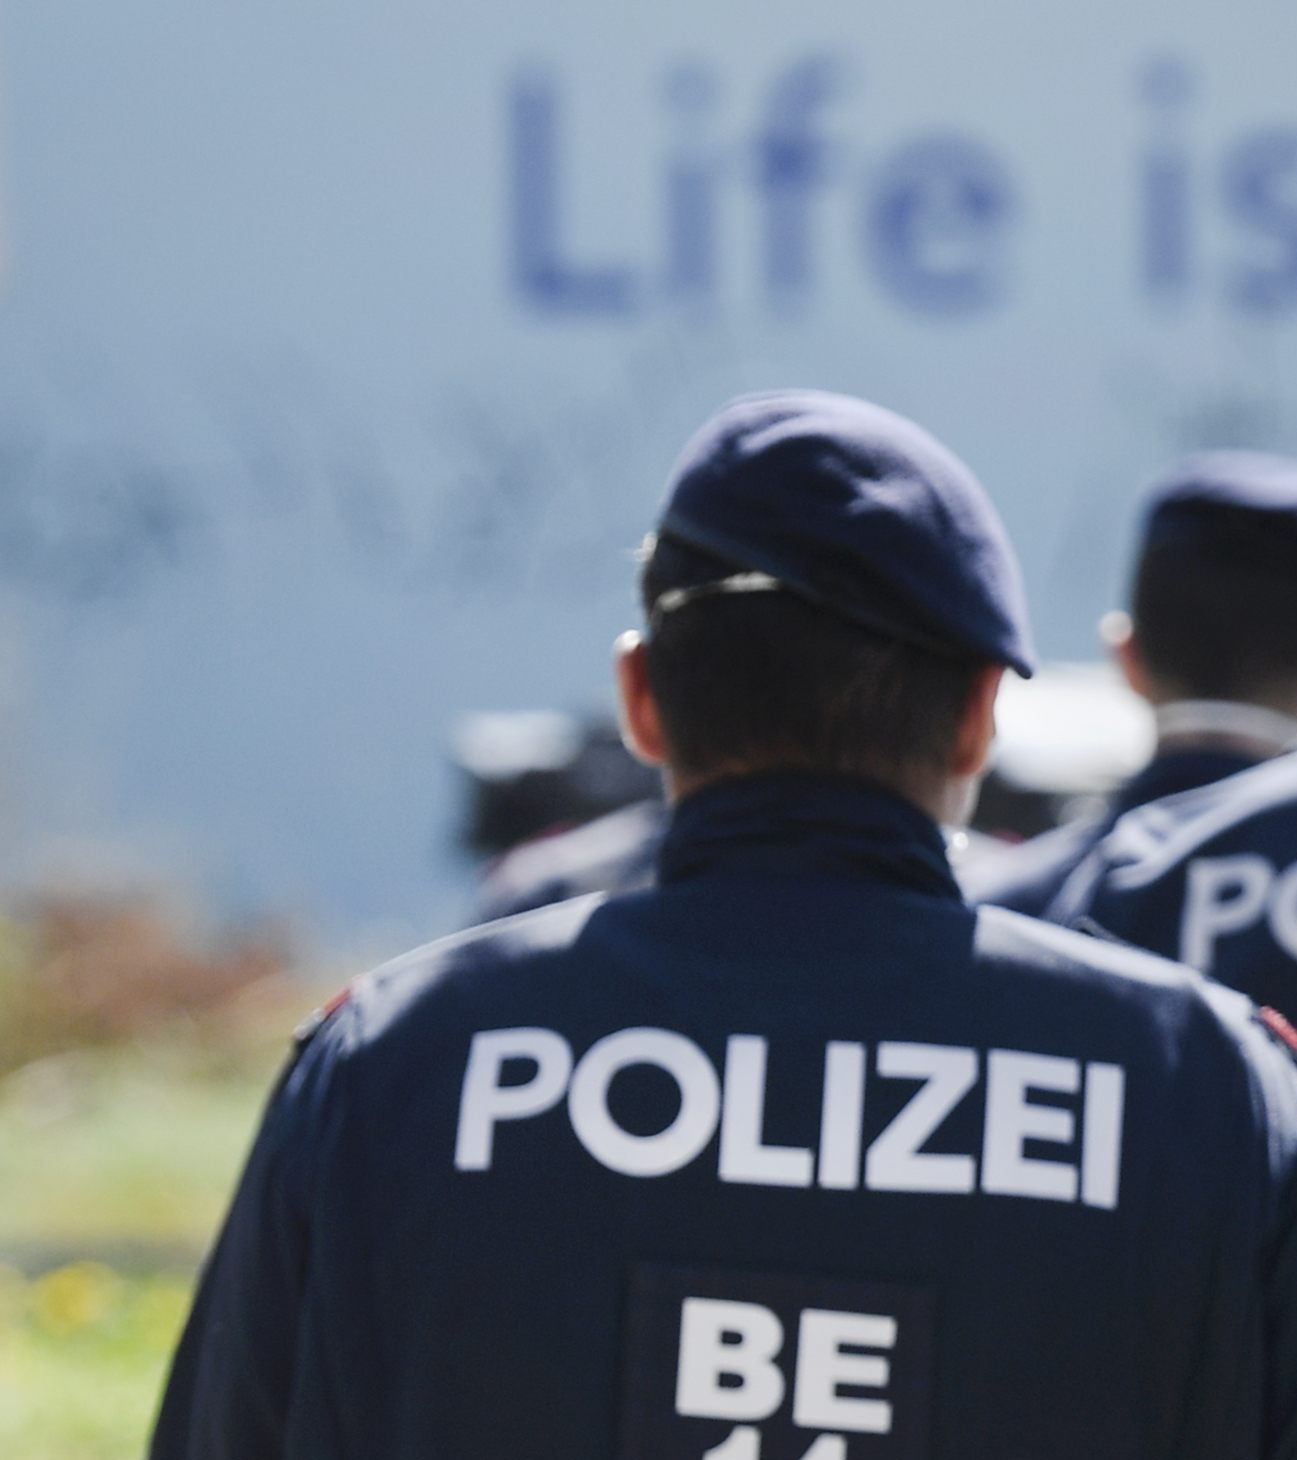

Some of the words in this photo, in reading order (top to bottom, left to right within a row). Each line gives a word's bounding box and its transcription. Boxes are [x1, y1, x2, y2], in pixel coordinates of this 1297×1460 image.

[500, 52, 1016, 320] Life
[455, 1026, 1125, 1209] POLIZEI
[676, 1297, 898, 1434] BE
